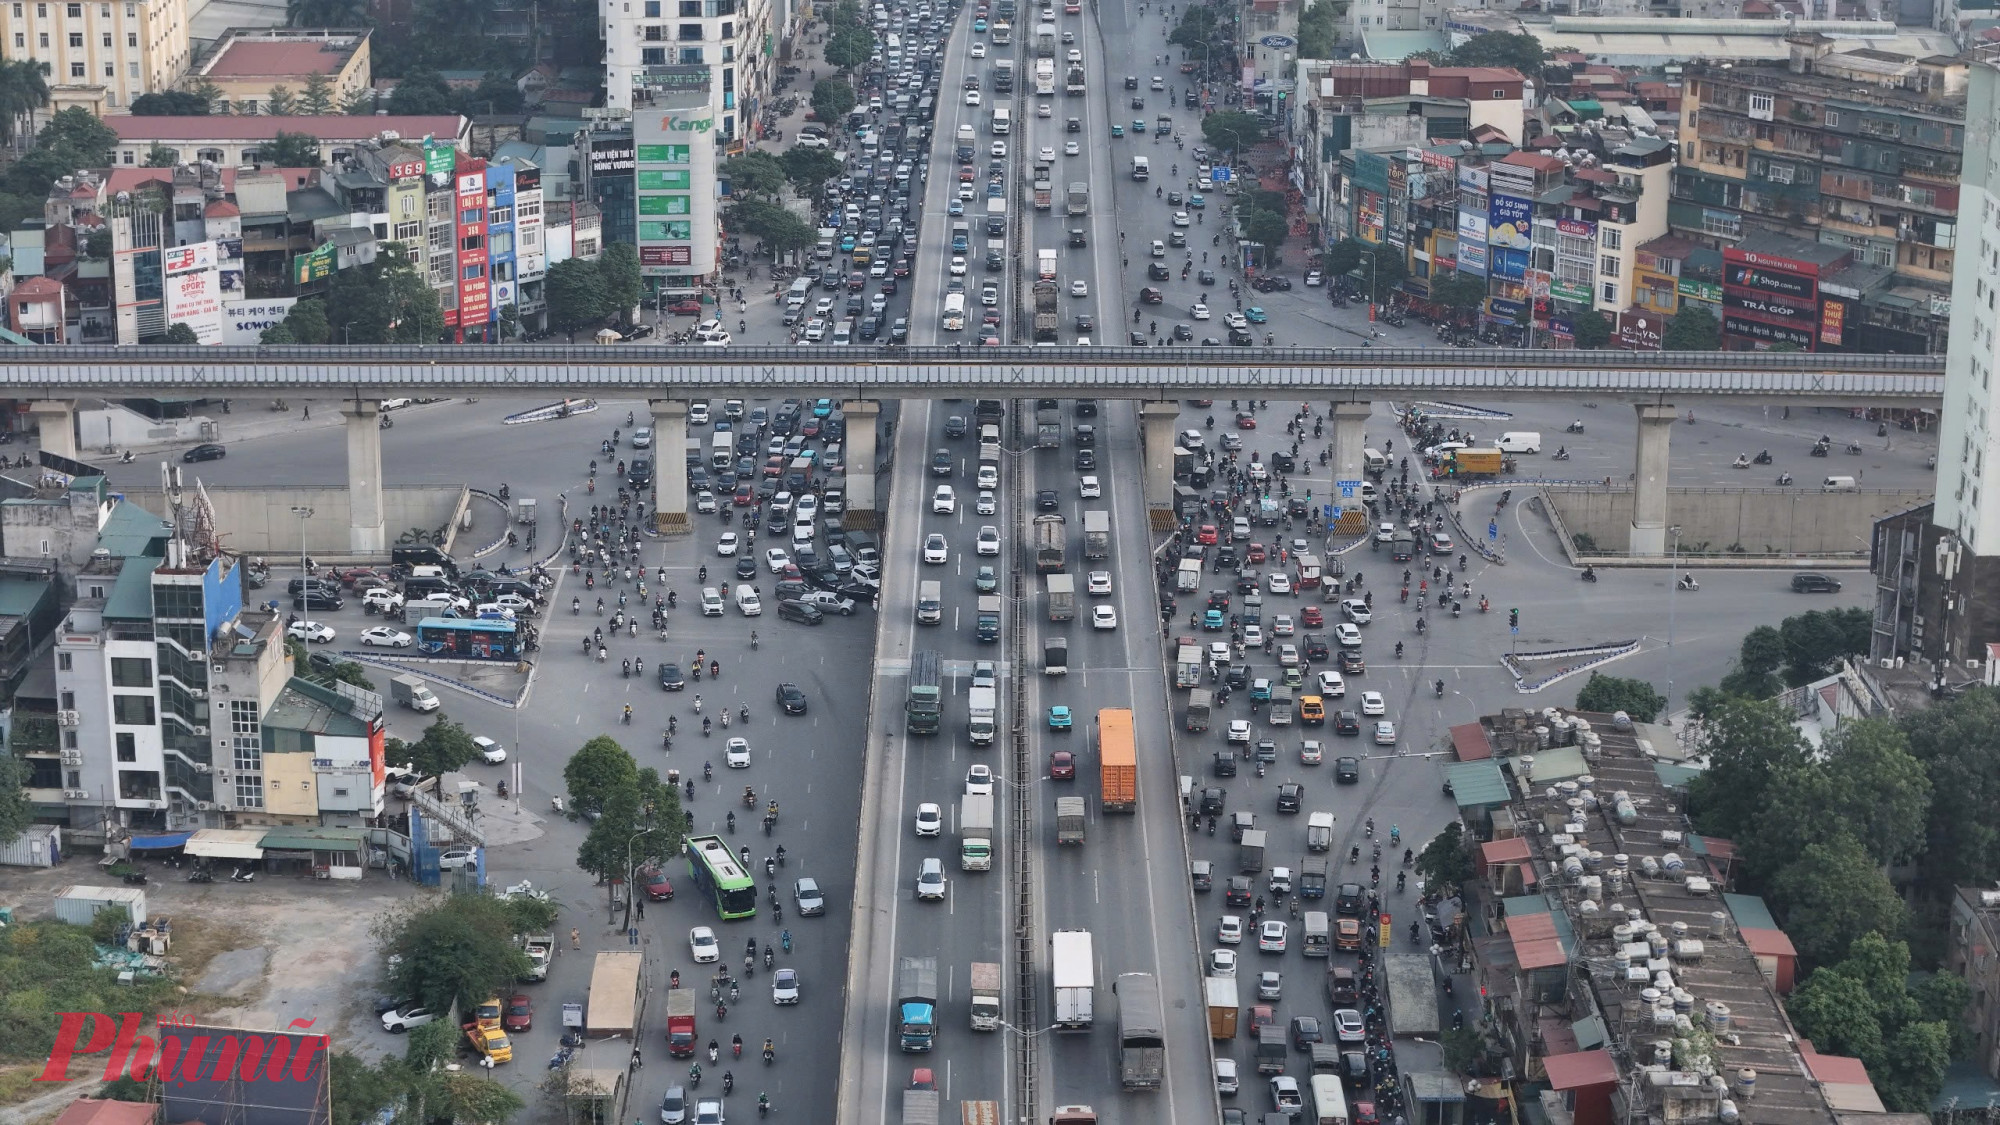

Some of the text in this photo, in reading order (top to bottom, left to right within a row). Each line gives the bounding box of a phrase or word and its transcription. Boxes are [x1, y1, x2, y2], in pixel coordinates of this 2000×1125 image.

[1266, 36, 1287, 46] Ford
[592, 151, 606, 161] BỆNH
[607, 150, 619, 160] VIỆN
[462, 197, 474, 208] LUẬT
[1561, 223, 1585, 234] có tiền
[1744, 252, 1757, 263] 10
[181, 281, 205, 292] SPORT
[228, 305, 285, 317] 뷰티 케어 센터
[1742, 299, 1794, 315] TRẢ GÓP
[1825, 301, 1842, 310] CHO
